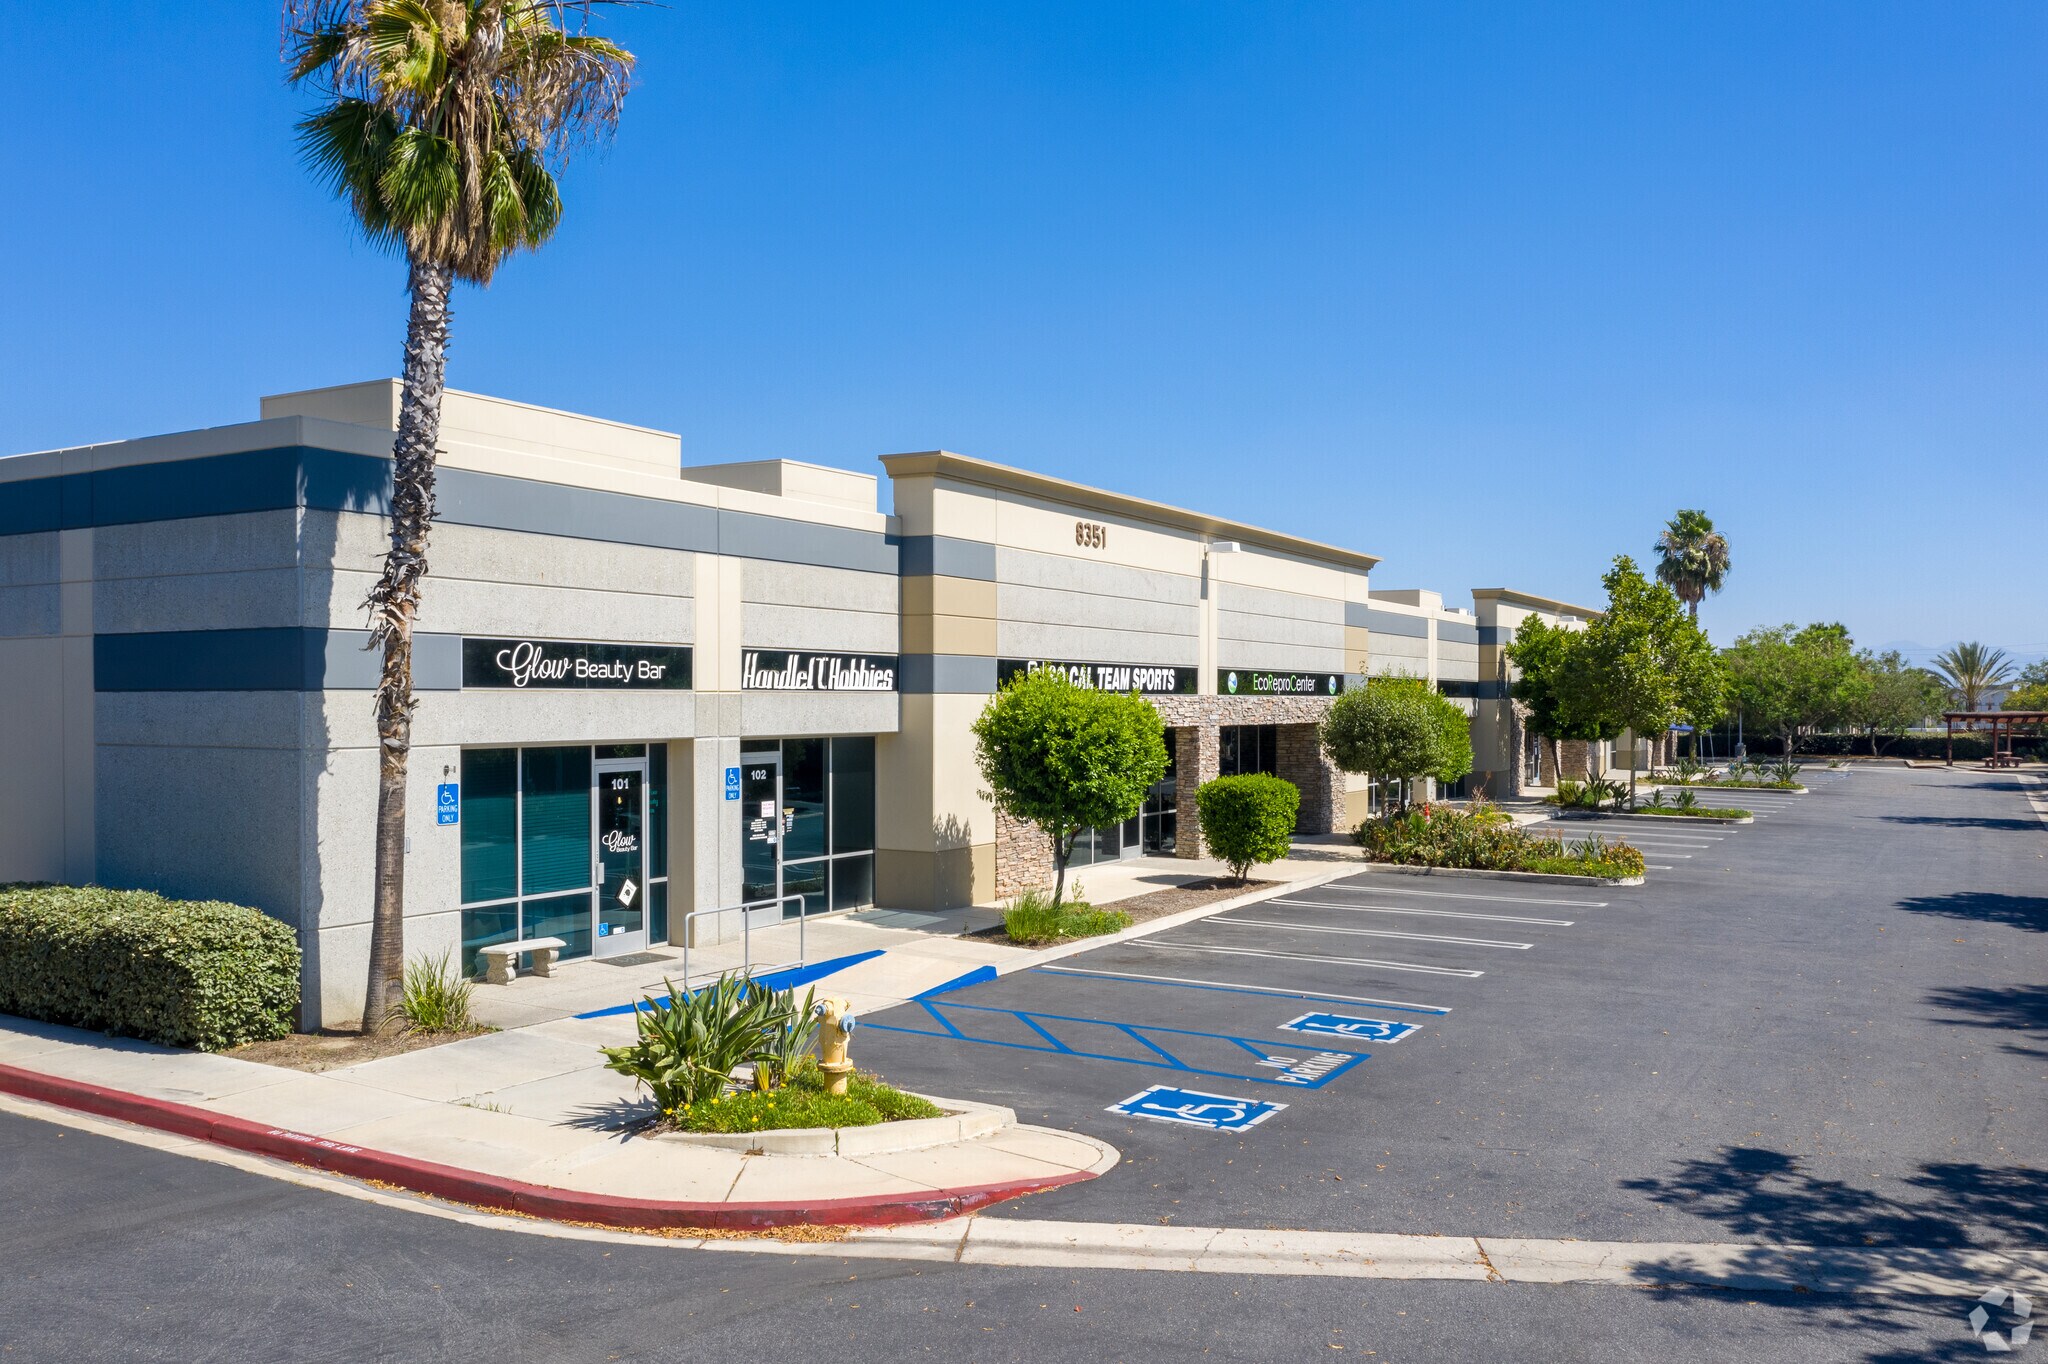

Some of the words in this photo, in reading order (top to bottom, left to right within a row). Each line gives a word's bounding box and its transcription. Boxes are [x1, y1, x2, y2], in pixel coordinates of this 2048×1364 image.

[1076, 521, 1106, 550] 8351
[496, 642, 573, 687] Glow
[575, 658, 633, 682] Beauty
[638, 660, 666, 679] Bar
[827, 657, 893, 690] Hobbies
[1069, 666, 1094, 690] CAL
[1097, 666, 1130, 690] TEAM
[1132, 668, 1175, 691] SPORTS
[1253, 673, 1315, 695] EcoReproCenter
[612, 778, 629, 790] 101
[751, 769, 767, 780] 102
[438, 804, 458, 813] PARKING
[442, 814, 454, 823] ONLY
[602, 830, 636, 852] Glow
[1255, 1056, 1298, 1069] NO
[1275, 1052, 1352, 1084] PARKING
